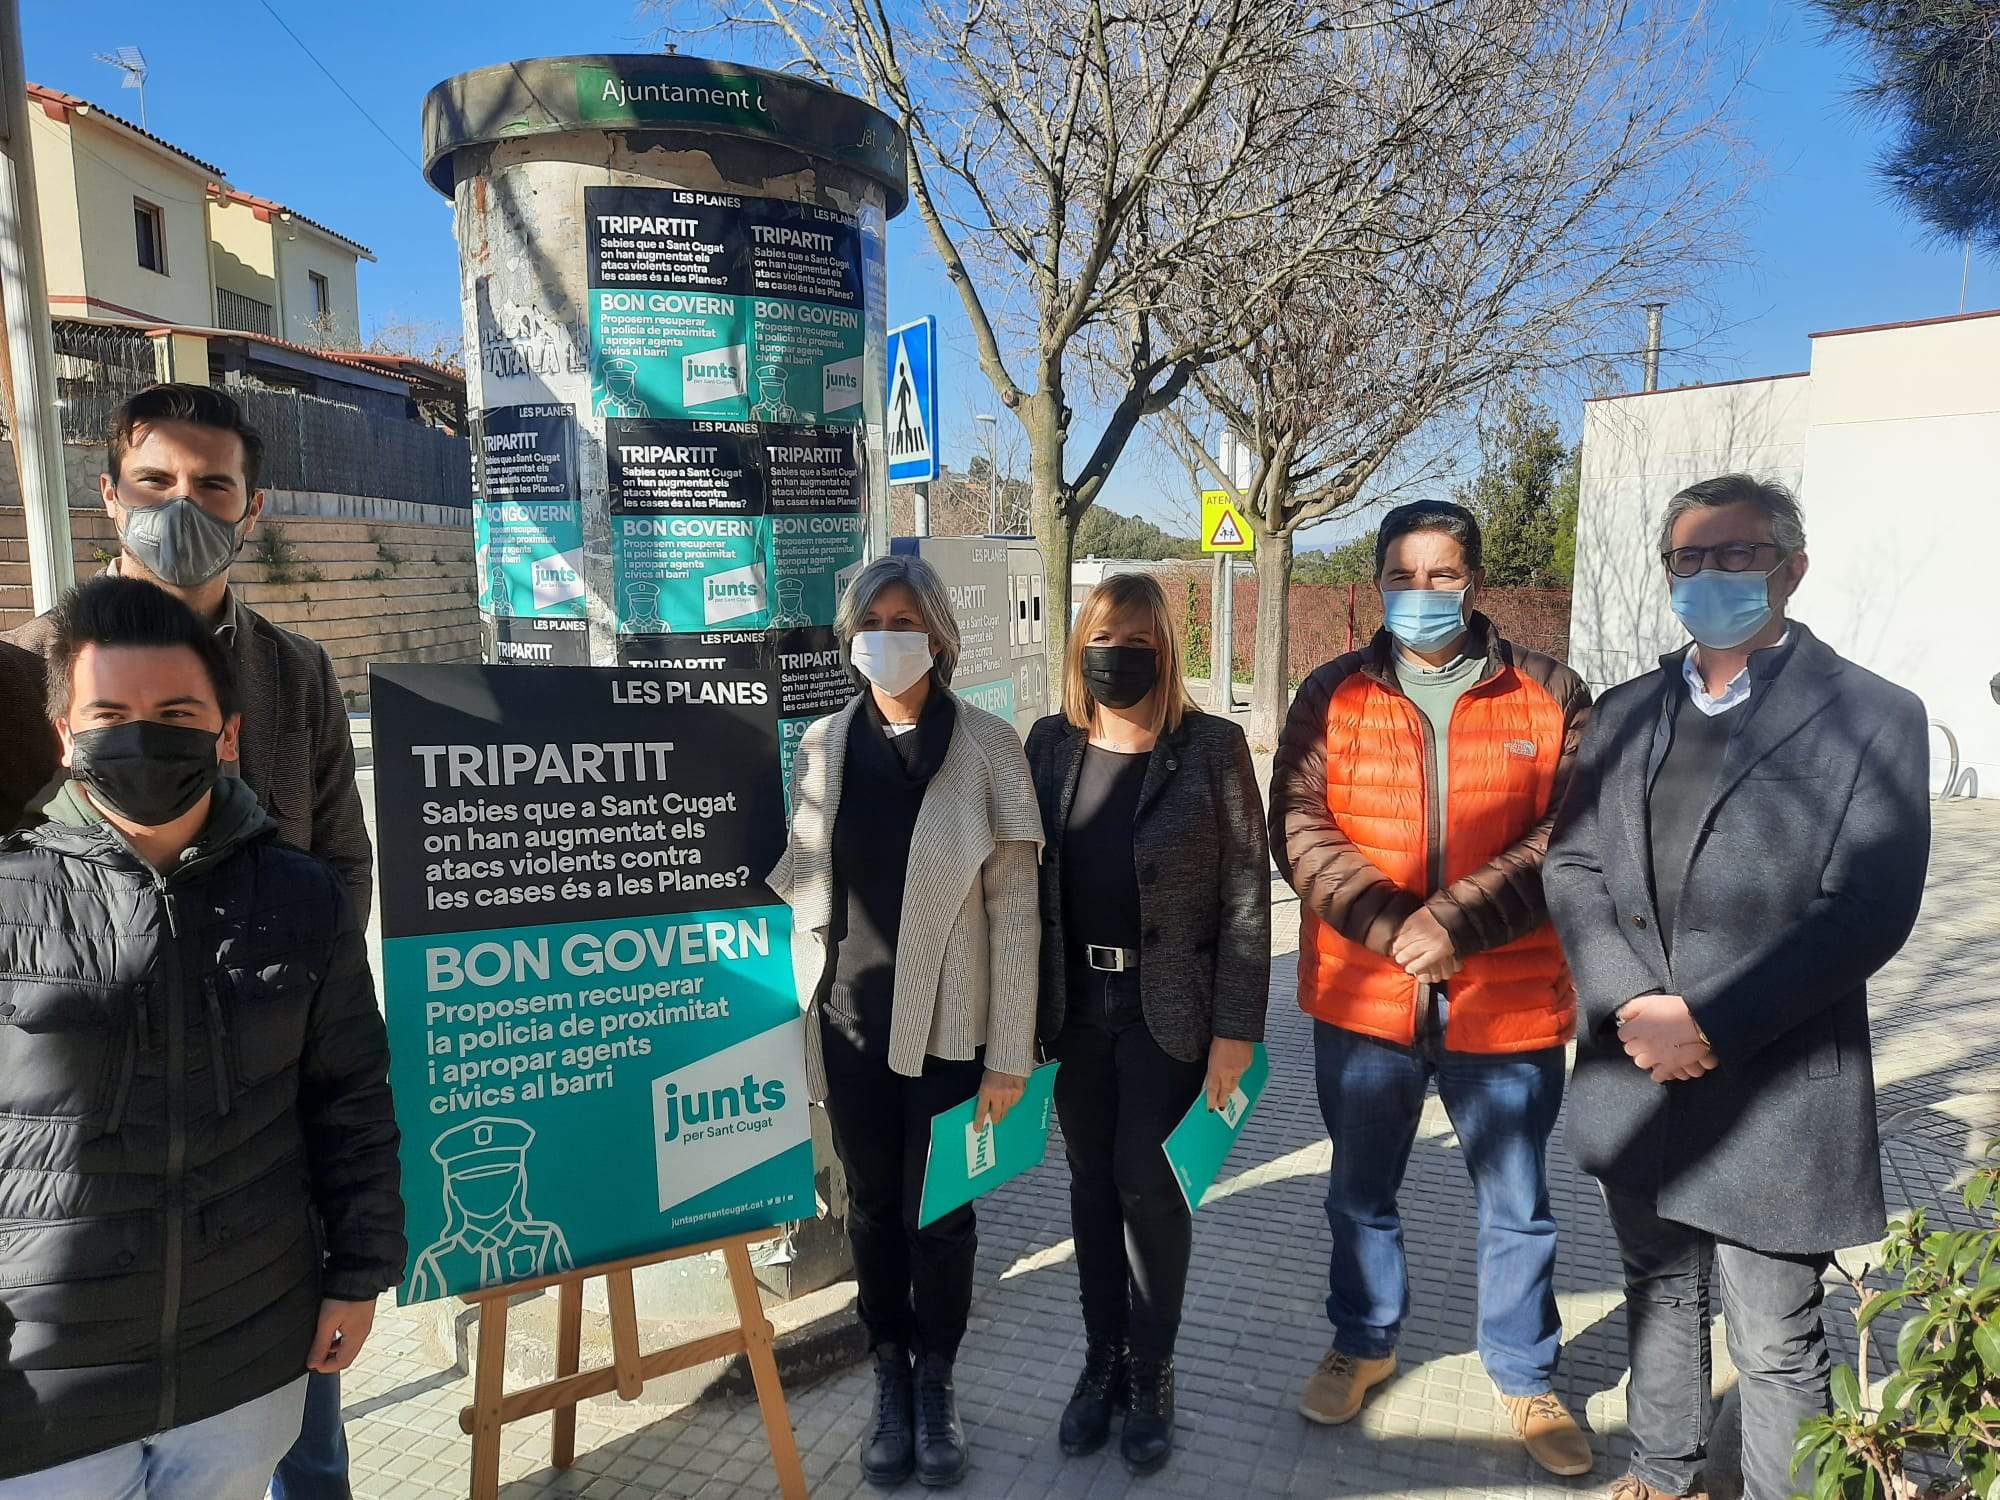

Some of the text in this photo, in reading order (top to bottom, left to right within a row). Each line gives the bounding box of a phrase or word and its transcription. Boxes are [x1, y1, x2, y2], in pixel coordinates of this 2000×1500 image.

[602, 80, 750, 110] Ajuntament
[673, 192, 741, 208] LES PLANES
[814, 208, 830, 220] LES
[597, 216, 698, 237] TRIPARTIT
[600, 238, 724, 255] Sabies que Sant Cugat
[751, 226, 833, 252] TRIPARTIT
[601, 249, 710, 263] on han augmentat els
[755, 247, 828, 264] Sabies que Sant
[601, 261, 708, 273] atacs violents contra
[769, 260, 786, 270] han
[832, 269, 842, 278] els
[602, 271, 728, 285] les cases és les Planes?
[755, 270, 815, 283] atacs violents
[756, 279, 854, 300] les cases Planes?
[601, 294, 734, 316] BON GOVERN
[601, 314, 705, 327] Proposem recuperar
[754, 301, 858, 328] BON GOVERN
[601, 325, 609, 334] la
[647, 326, 660, 334] de
[662, 327, 716, 338] proximitat
[754, 321, 838, 338] Proposem recuperar
[606, 337, 683, 348] apropar agents
[632, 348, 642, 356] al
[643, 348, 667, 357] barri
[687, 359, 738, 381] junts
[826, 369, 856, 389] junts
[520, 406, 573, 417] LES PLANES
[693, 421, 758, 433] LES PLANES
[483, 432, 538, 452] TRIPARTIT
[534, 453, 560, 464] Cugat
[618, 446, 717, 463] TRIPARTIT
[766, 446, 842, 463] TRIPARTIT
[521, 475, 547, 483] contra
[622, 467, 742, 479] Sabies que Sant Cugat
[532, 484, 565, 493] Planes?
[637, 478, 656, 487] han
[658, 479, 713, 489] augmentat
[714, 479, 729, 487] els
[623, 488, 727, 497] atacs violents contra
[1207, 496, 1231, 504] ATEN
[624, 498, 638, 507] les
[692, 499, 707, 508] les
[709, 499, 747, 508] Planes?
[510, 505, 572, 521] GOVERN
[623, 520, 753, 537] BON GOVERN
[773, 518, 866, 534] BON GOVERN
[624, 540, 726, 549] Proposem recuperar
[624, 550, 632, 558] la
[669, 550, 682, 558] de
[684, 550, 736, 560] proximitat
[629, 560, 704, 570] apropar agents
[535, 565, 576, 585] junts
[655, 570, 663, 578] al
[666, 570, 689, 578] barri
[708, 580, 758, 600] junts
[948, 585, 986, 610] PARTIT
[533, 620, 586, 631] LES PLANES
[701, 633, 765, 644] LES PLANES
[497, 642, 552, 660] TRIPARTIT
[778, 650, 842, 670] TRIPART
[782, 674, 808, 683] Sabies
[612, 681, 768, 706] LES PLANES
[783, 693, 805, 701] atacs
[411, 742, 673, 788] TRIPARTIT
[422, 791, 736, 825] Sabies que a Sant Cugat
[424, 819, 705, 854] on han augmentat els
[425, 844, 701, 882] atacs violents contra
[427, 865, 750, 910] les cases és a les Planes?
[425, 917, 769, 993] BON GOVERN
[426, 975, 704, 1026] Proposem recuperar
[427, 997, 729, 1056] la policia de proximitat
[428, 1036, 652, 1087] i apropar agents
[430, 1065, 614, 1114] cívics al barri
[664, 1074, 786, 1142] junts
[682, 1117, 772, 1146] per Sant Cugat
[971, 1122, 990, 1172] junts
